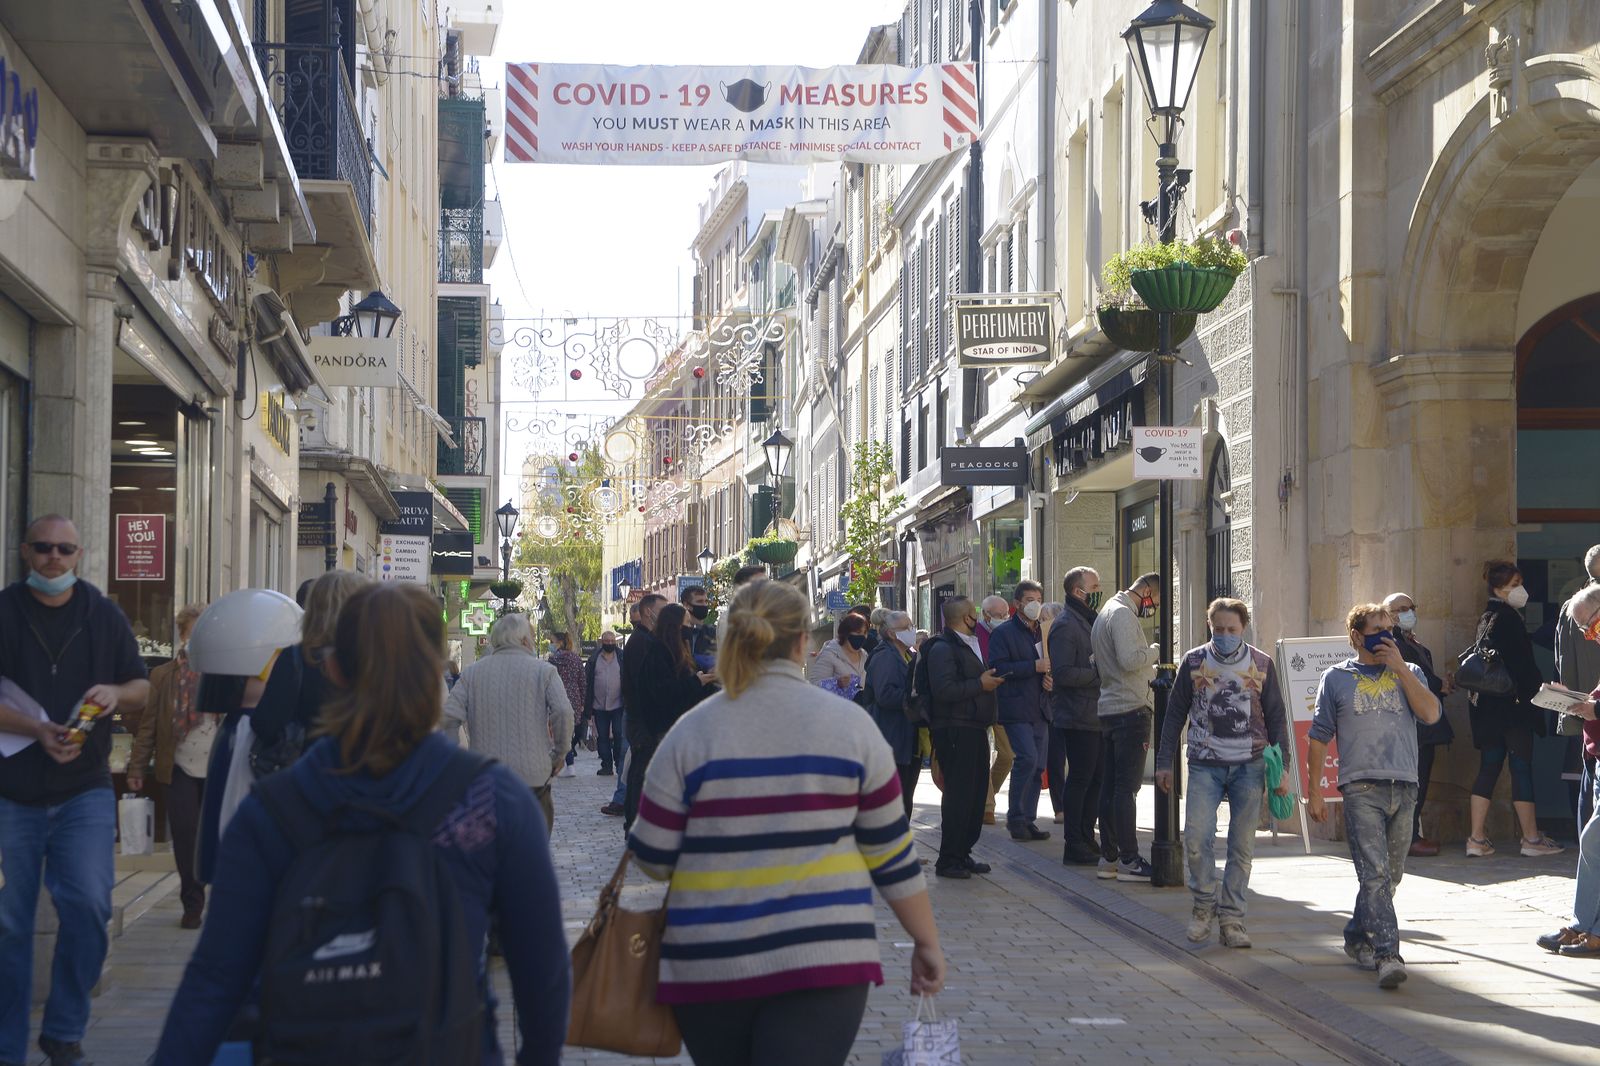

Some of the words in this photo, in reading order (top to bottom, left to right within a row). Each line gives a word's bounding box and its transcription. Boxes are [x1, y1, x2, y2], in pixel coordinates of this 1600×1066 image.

[553, 82, 651, 106] COVID
[678, 84, 711, 107] 19
[780, 82, 928, 107] MEASURES
[593, 117, 627, 130] YOU
[632, 117, 680, 130] MUST
[684, 118, 731, 131] WEAR
[735, 119, 745, 131] A
[750, 116, 795, 132] MASK
[799, 117, 814, 130] IN
[818, 117, 849, 131] THIS
[853, 116, 891, 131] AREA
[561, 142, 593, 151] WASH
[594, 142, 624, 152] YOUR
[626, 143, 664, 152] HANDS
[672, 143, 697, 152] KEEP
[699, 143, 706, 152] A
[708, 143, 733, 153] SAFE
[734, 141, 781, 153] DISTANCE
[789, 142, 836, 152] MINIMISE
[837, 141, 872, 153] SOCIAL
[875, 141, 921, 151] CONTACT
[962, 311, 1046, 339] PERFUMERY
[972, 347, 994, 356] STAR
[997, 347, 1009, 355] OF
[1012, 346, 1038, 354] INDIA
[314, 353, 387, 368] PANDORA
[1144, 429, 1188, 438] COVID-19
[950, 461, 1018, 469] PEACOCKS
[399, 507, 429, 515] ERUYA
[128, 519, 150, 532] HEY
[1131, 515, 1148, 532] CHANEL
[127, 531, 155, 543] YOU!
[432, 550, 473, 558] MAC
